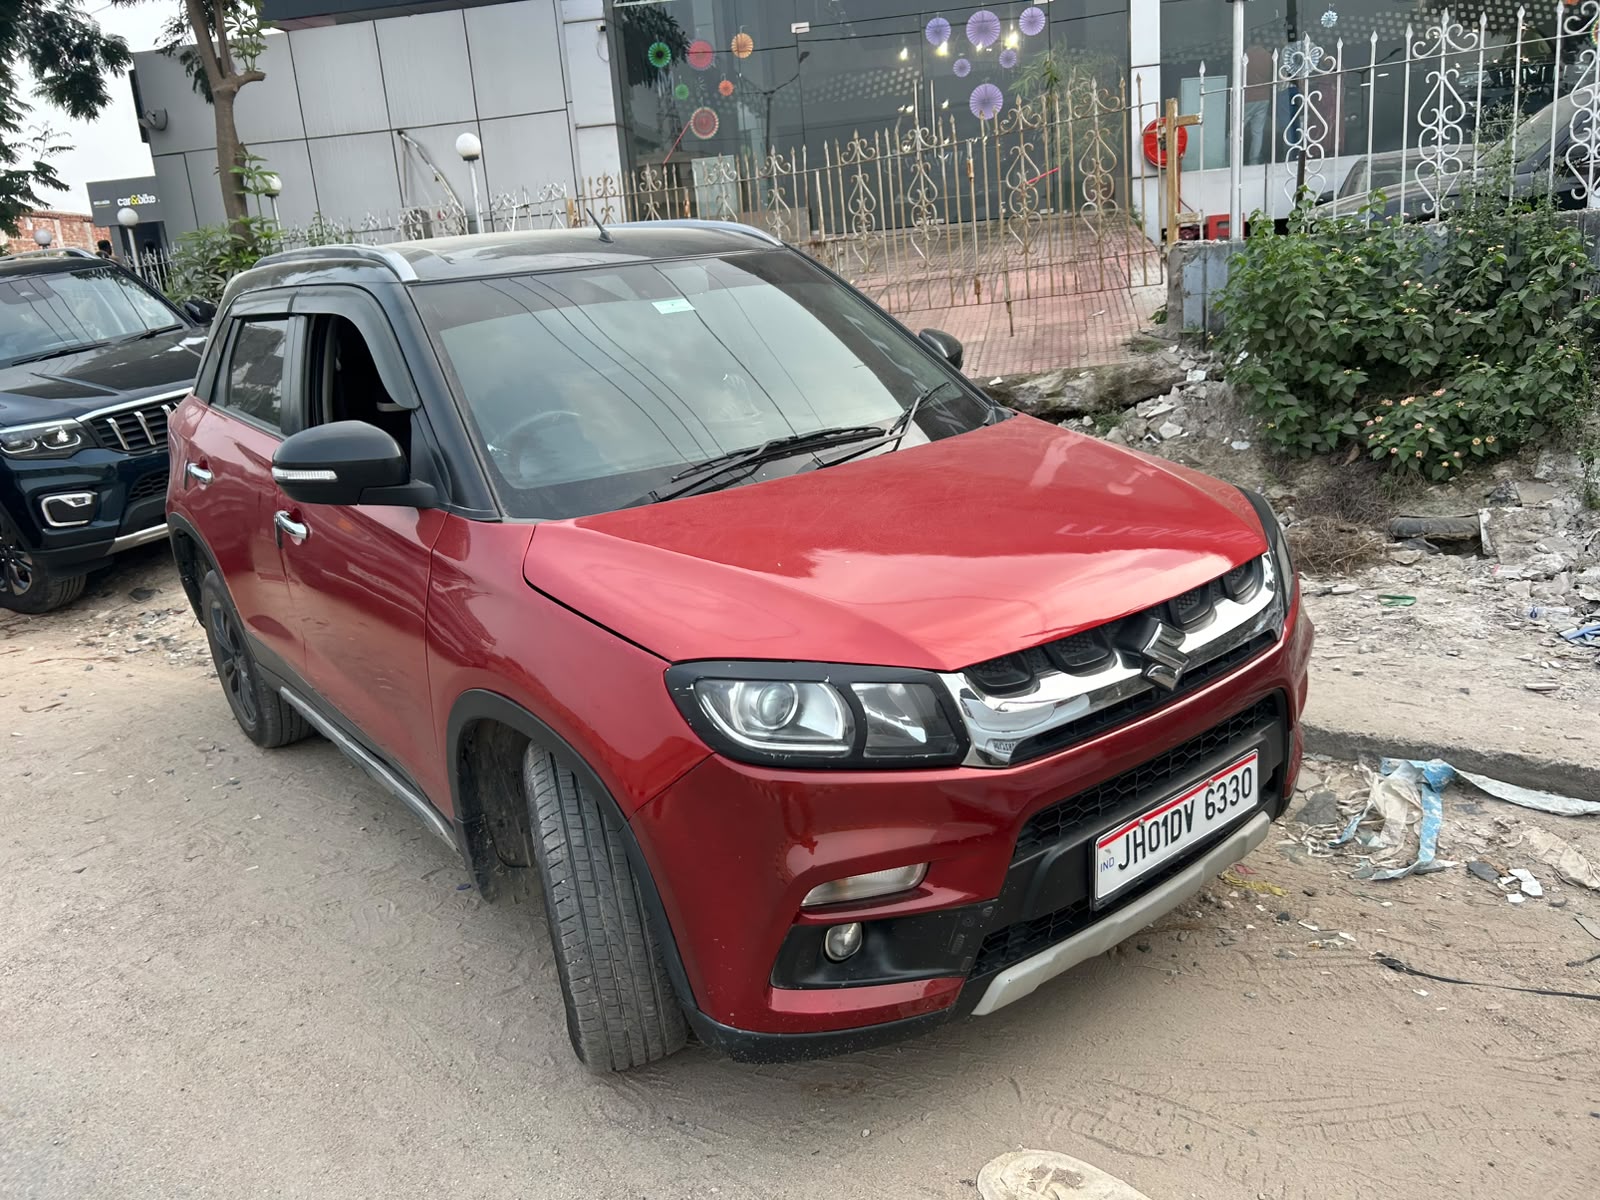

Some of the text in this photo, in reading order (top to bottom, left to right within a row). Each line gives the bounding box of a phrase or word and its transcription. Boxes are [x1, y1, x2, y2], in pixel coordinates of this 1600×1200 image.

[1118, 767, 1252, 871] JH01DV 6330
[1100, 856, 1115, 872] IND
